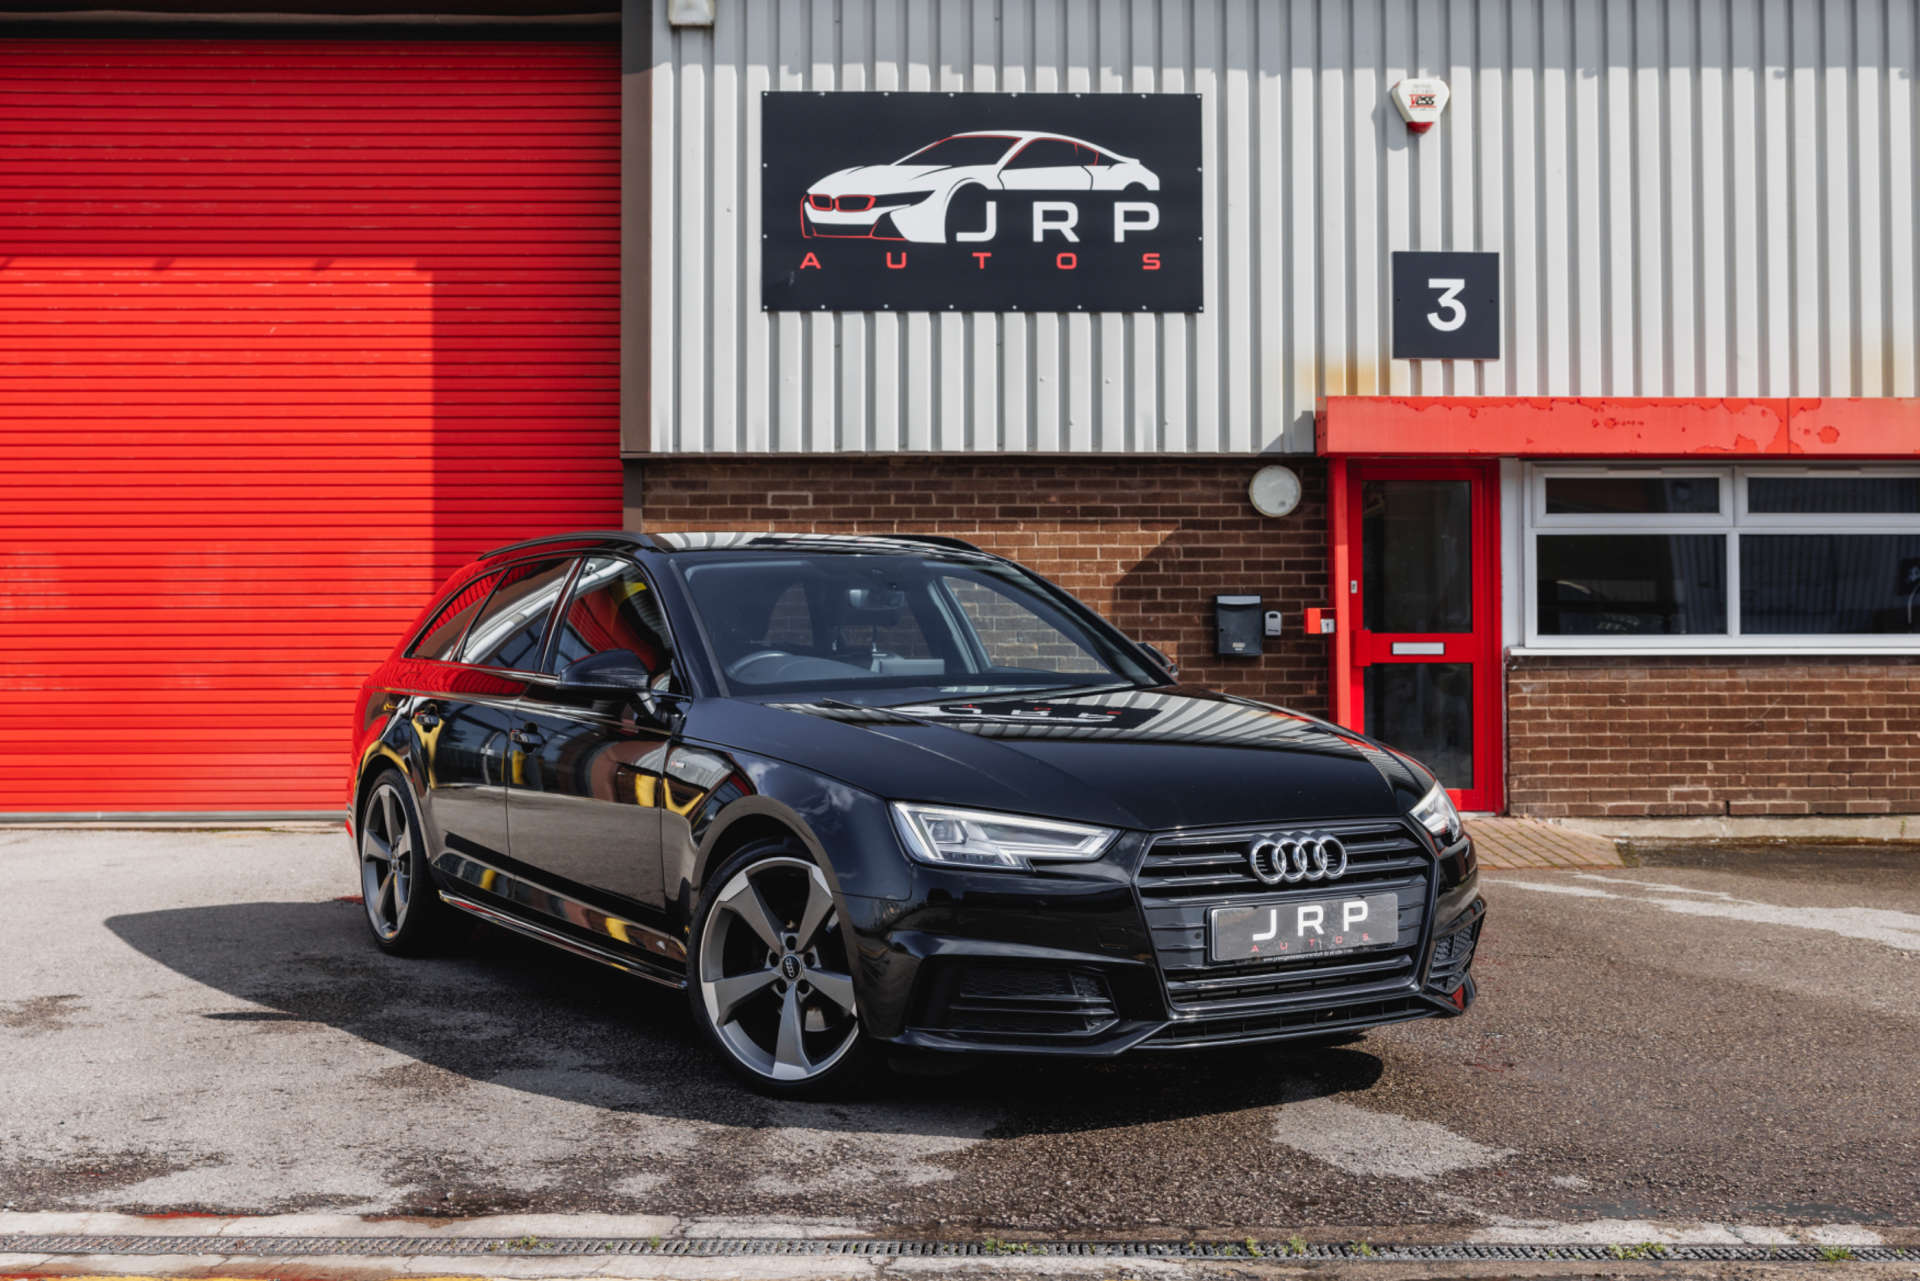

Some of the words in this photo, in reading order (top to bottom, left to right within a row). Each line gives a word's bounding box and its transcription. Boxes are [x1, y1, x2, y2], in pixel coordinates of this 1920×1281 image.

[955, 200, 1160, 243] JRP
[800, 251, 1162, 271] AUTOS
[1426, 278, 1467, 332] 3
[1252, 900, 1369, 942] JRP
[1251, 932, 1369, 953] AUTOS
